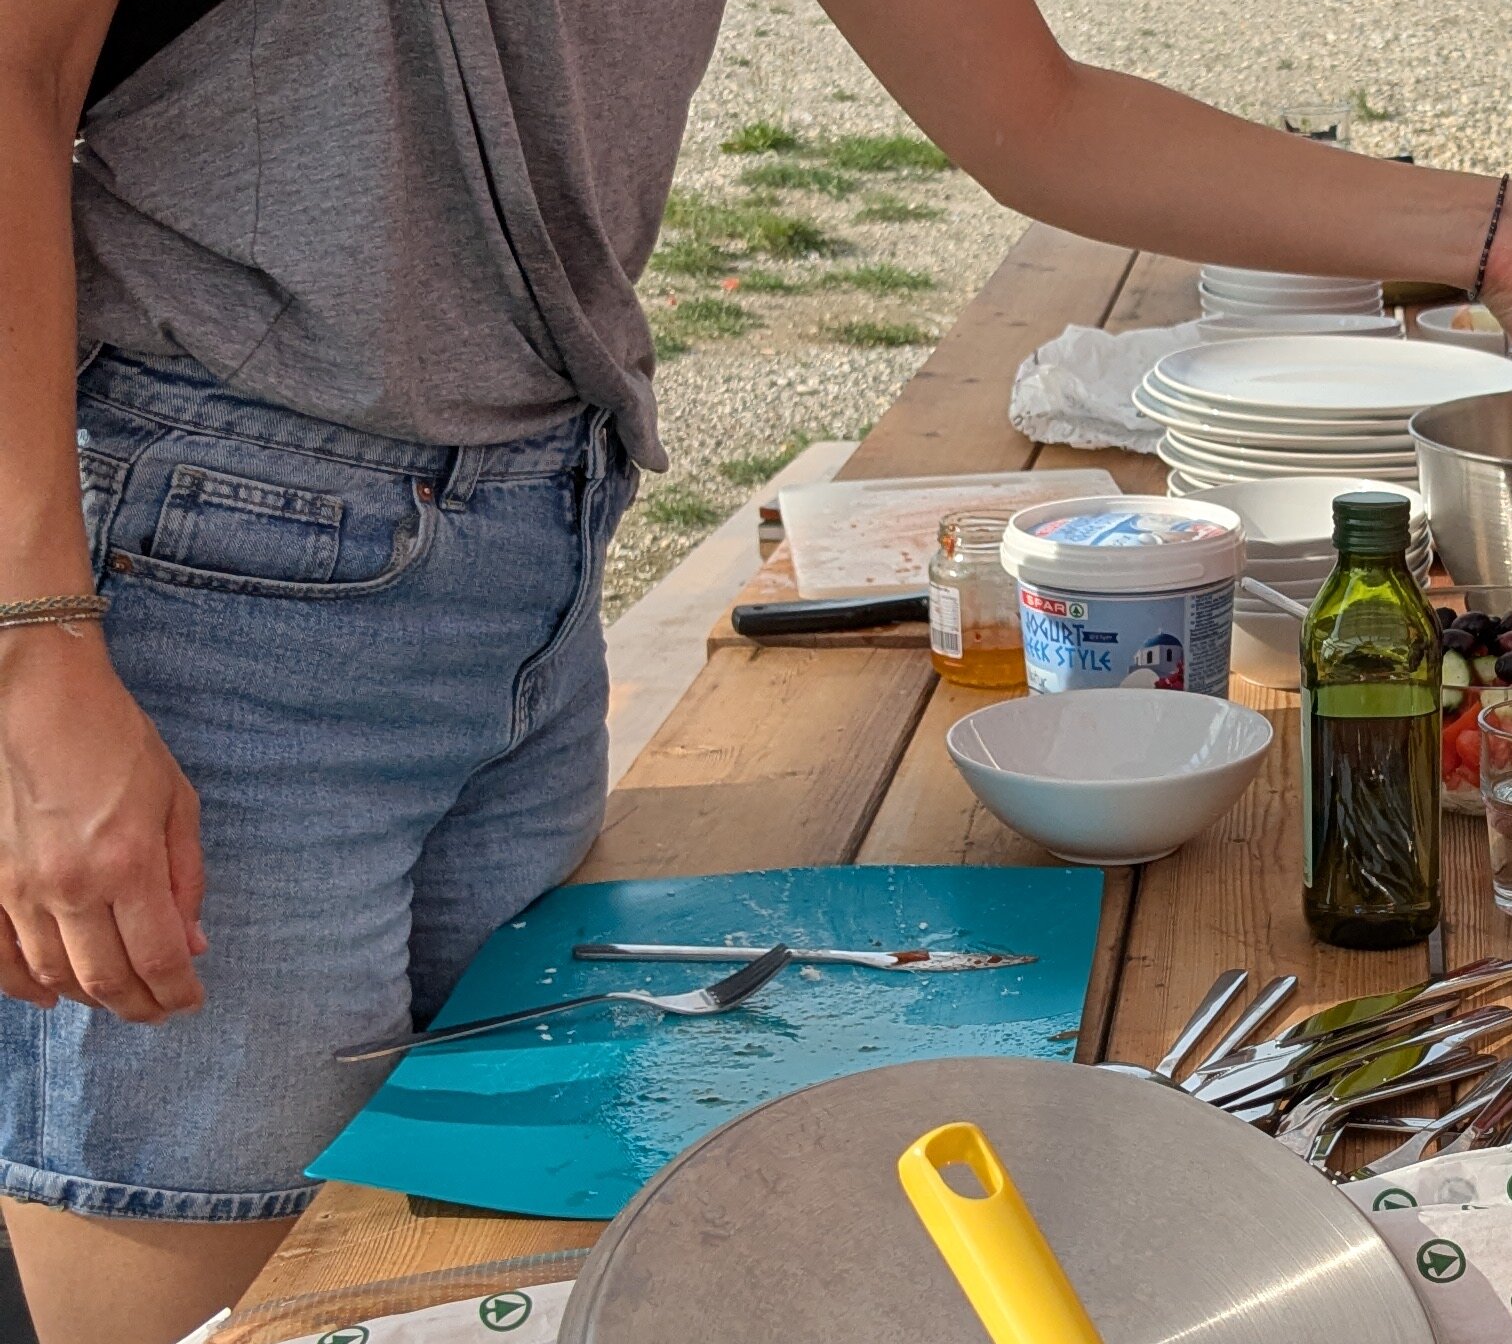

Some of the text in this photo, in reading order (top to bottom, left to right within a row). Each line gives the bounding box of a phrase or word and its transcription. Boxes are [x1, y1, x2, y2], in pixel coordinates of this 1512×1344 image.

[1026, 595, 1066, 614] SPAR
[1026, 611, 1085, 647] JOGURT
[1055, 645, 1112, 672] STYLE
